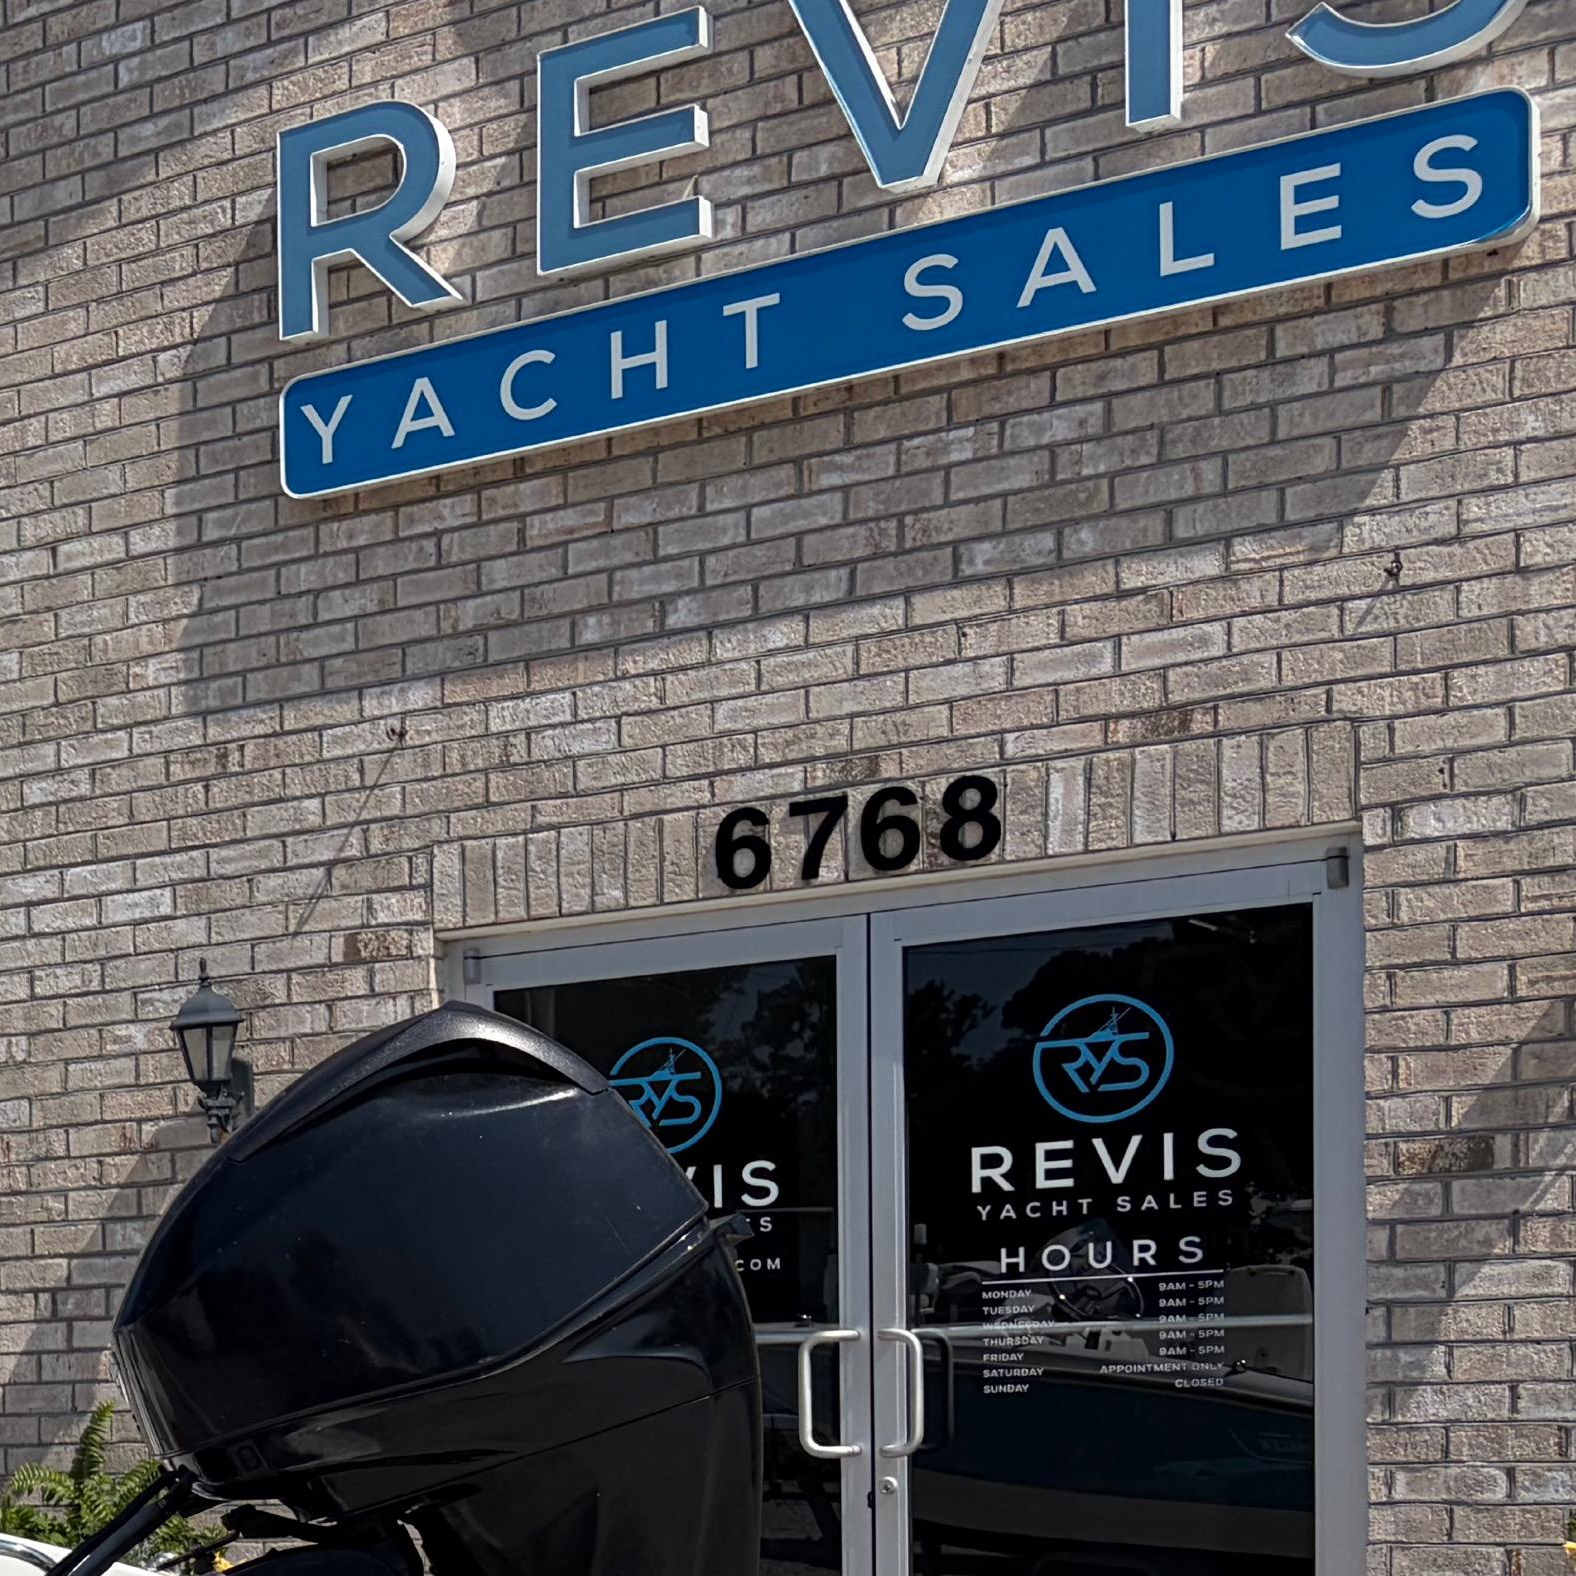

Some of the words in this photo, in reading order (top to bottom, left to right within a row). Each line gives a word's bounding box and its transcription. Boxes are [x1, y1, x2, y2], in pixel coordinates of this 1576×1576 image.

[300, 292, 780, 465] YACHT
[902, 134, 1483, 332] SALES
[715, 775, 1002, 890] 6768
[971, 1127, 1242, 1193] REVIS
[977, 1198, 1093, 1221] YACHT
[1116, 1189, 1234, 1213] SALES
[1000, 1236, 1204, 1274] HOURS
[981, 1289, 1032, 1299] MONDAY
[1158, 1282, 1187, 1292] 9AM
[1197, 1280, 1225, 1289] 5PM
[982, 1305, 1036, 1315] TUESDAY
[1158, 1298, 1187, 1308] 9AM
[1197, 1296, 1225, 1306] 5PM
[1158, 1314, 1187, 1324] 9AM
[1197, 1312, 1225, 1322] 5PM
[982, 1336, 1044, 1347] THURSDAY
[1158, 1330, 1187, 1340] 9AM
[1197, 1328, 1225, 1338] 5PM
[983, 1352, 1025, 1362] FRIDAY
[1158, 1346, 1187, 1356] 9AM
[1197, 1345, 1225, 1355] 5PM
[982, 1367, 1044, 1378] SATURDAY
[1099, 1363, 1188, 1375] APPOINTMENT
[1191, 1361, 1225, 1372] ONLY
[983, 1384, 1029, 1394] SUNDAY
[1174, 1378, 1225, 1389] CLOSED
